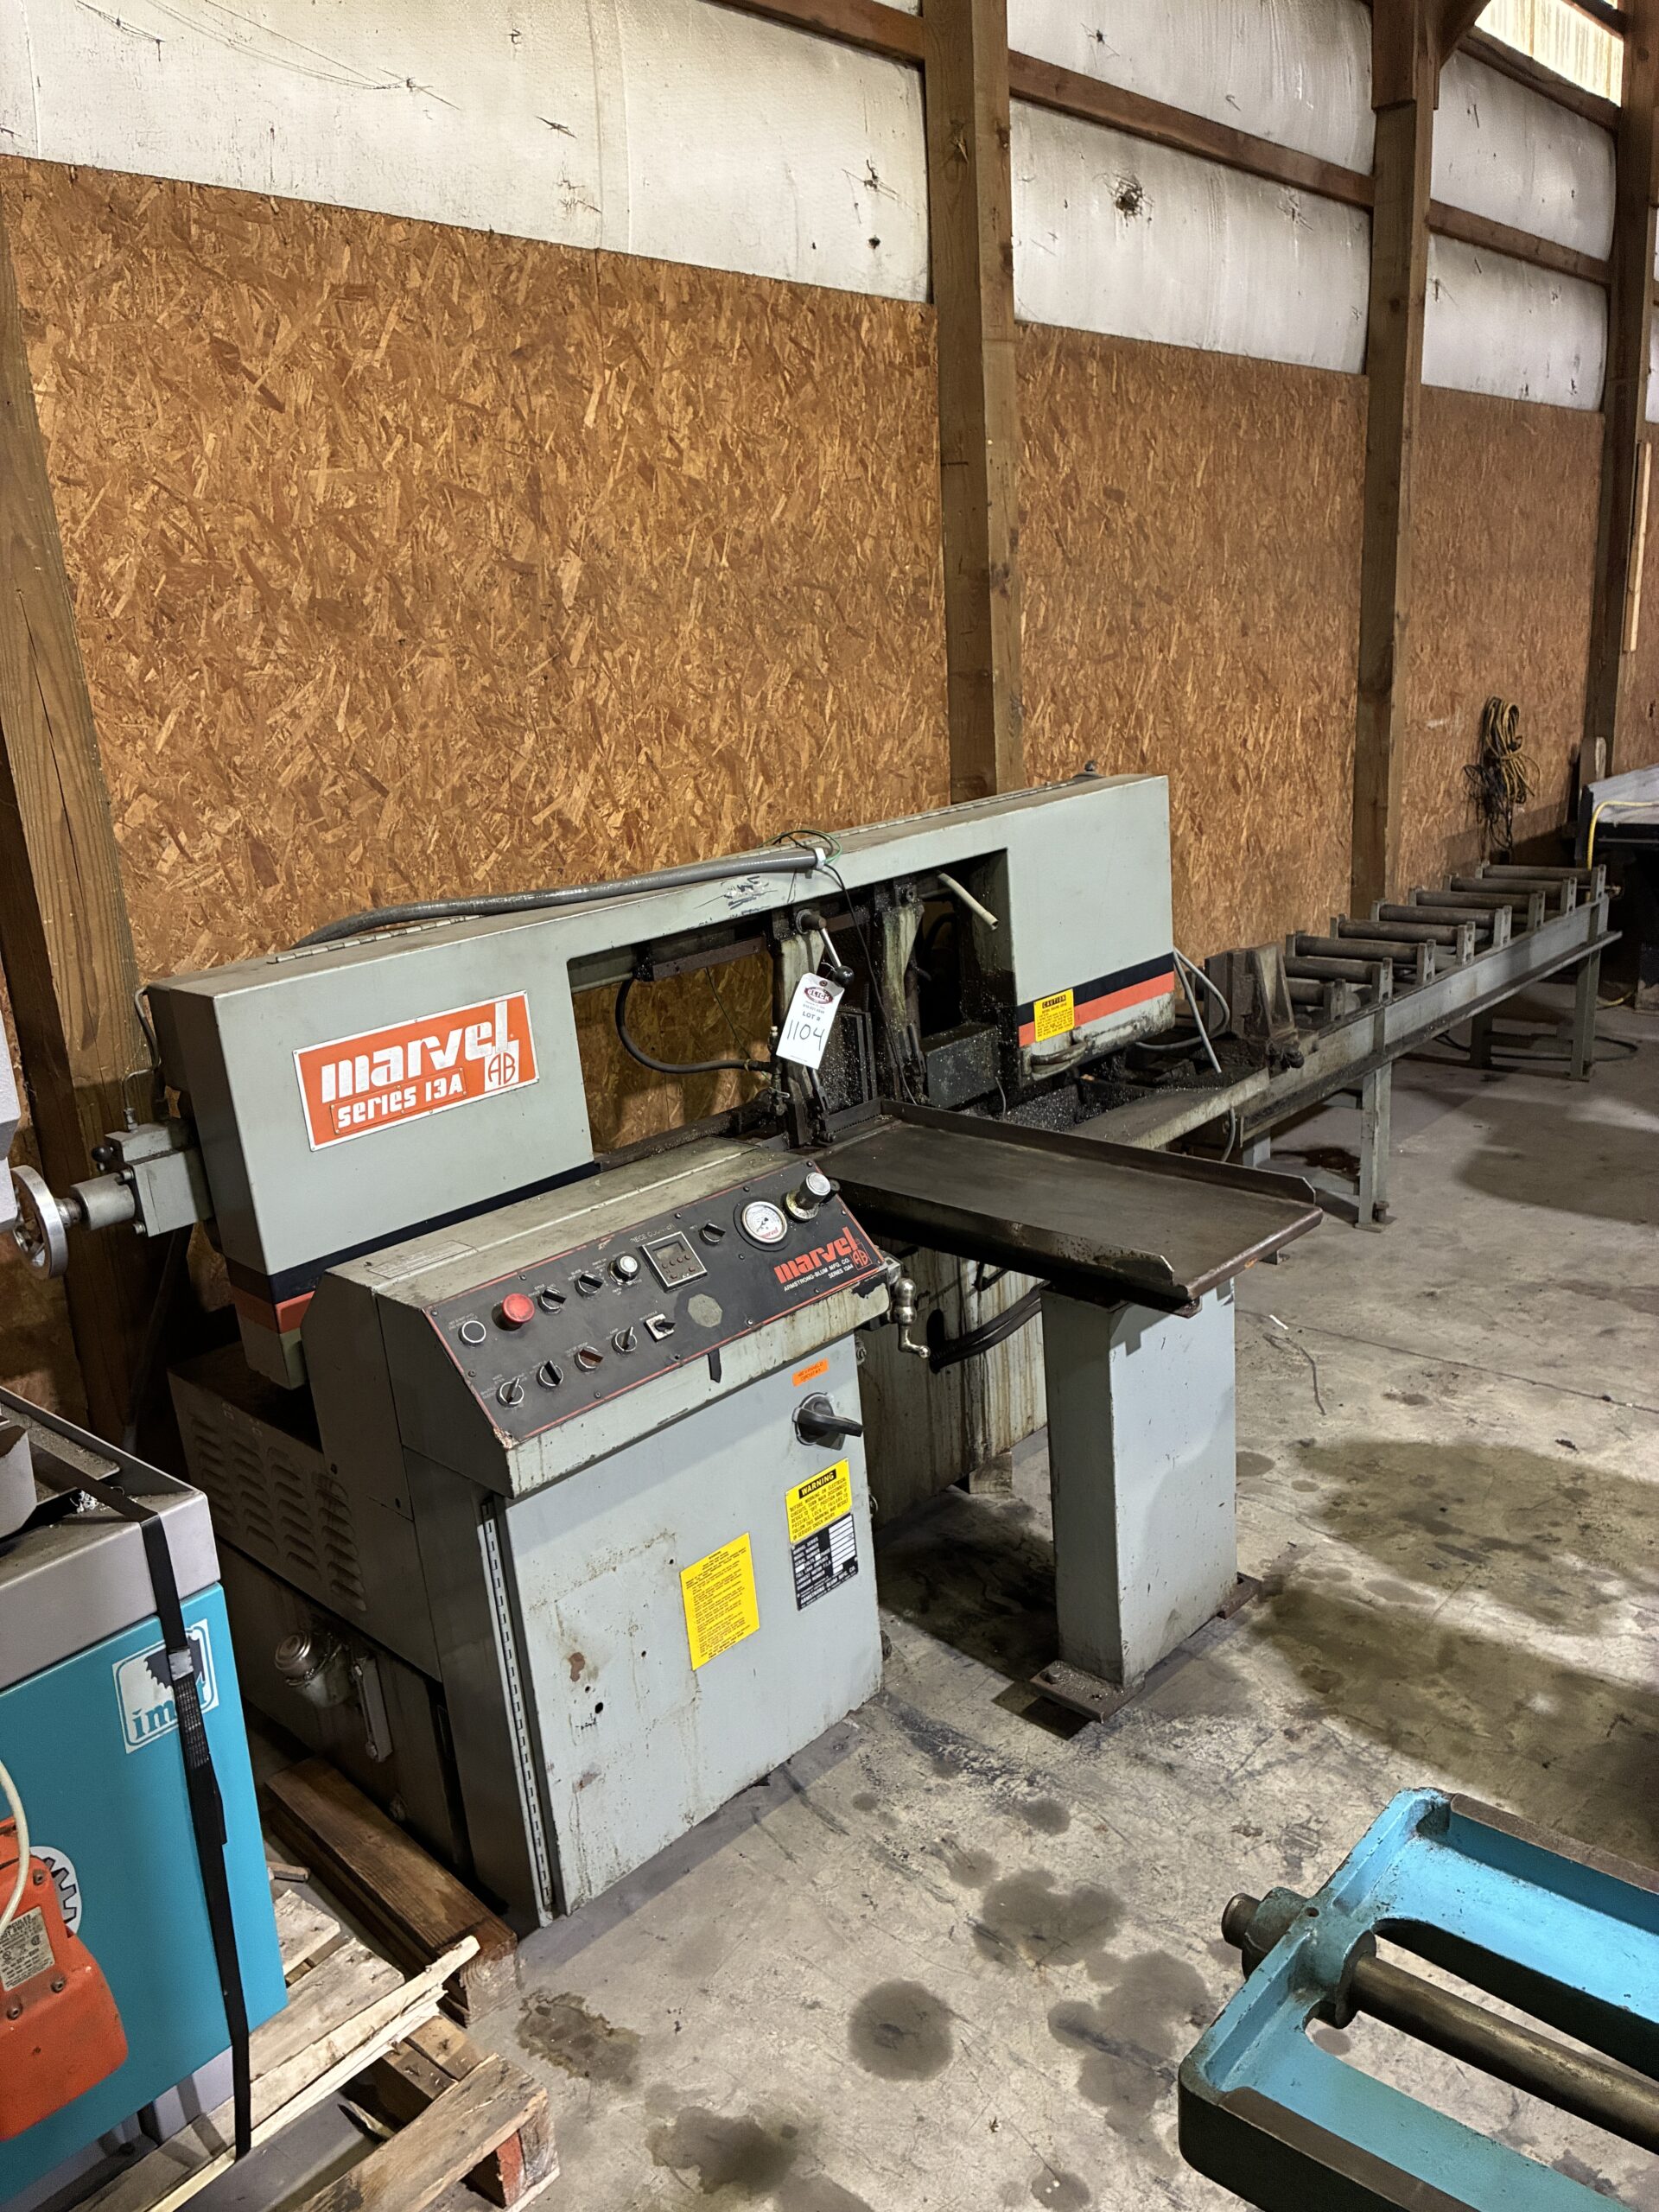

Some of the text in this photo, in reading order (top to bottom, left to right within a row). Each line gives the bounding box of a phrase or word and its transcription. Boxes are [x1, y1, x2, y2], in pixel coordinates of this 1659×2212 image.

[786, 1020, 825, 1051] 1104
[802, 1011, 816, 1020] LOT
[321, 1001, 508, 1103] marvel
[338, 1084, 416, 1128] series
[774, 1227, 857, 1284] marvel
[801, 1471, 835, 1497] WARNING
[133, 1678, 207, 1739] imt
